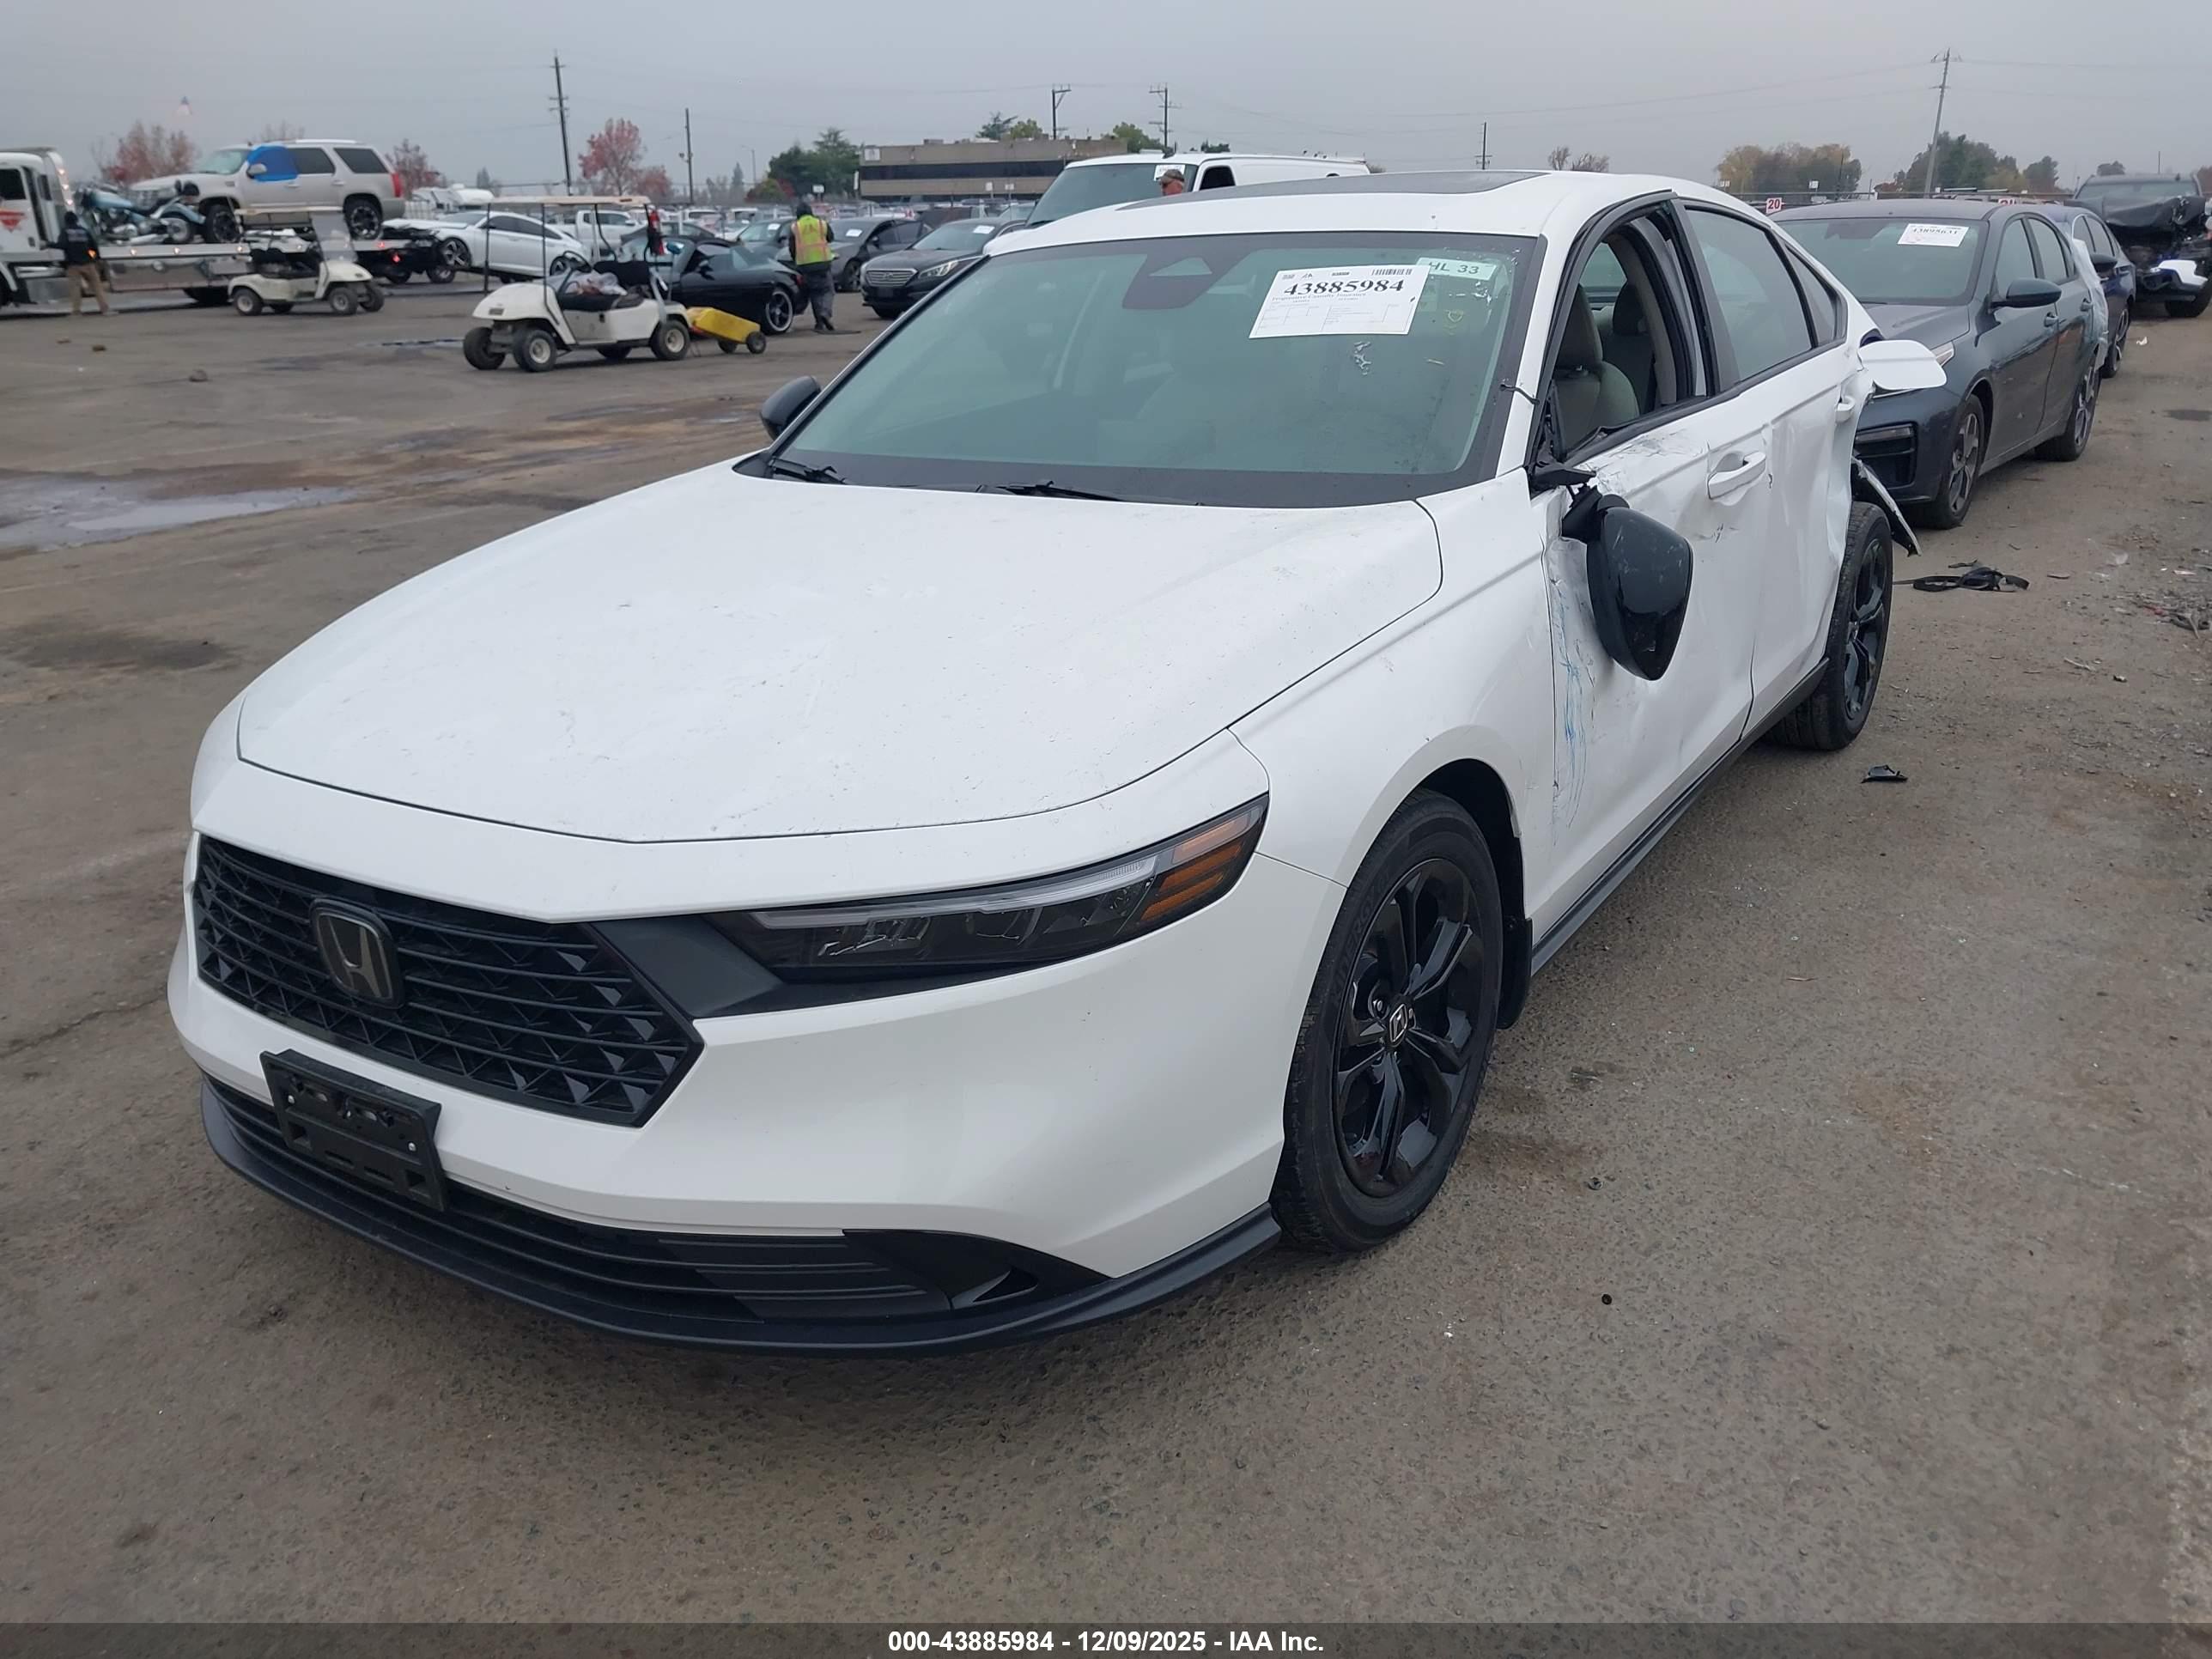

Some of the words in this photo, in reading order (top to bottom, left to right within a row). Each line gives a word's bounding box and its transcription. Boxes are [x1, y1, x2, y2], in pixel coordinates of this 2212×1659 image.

[1767, 198, 1781, 210] 20
[1457, 264, 1480, 275] 33
[1284, 279, 1405, 295] 43885984
